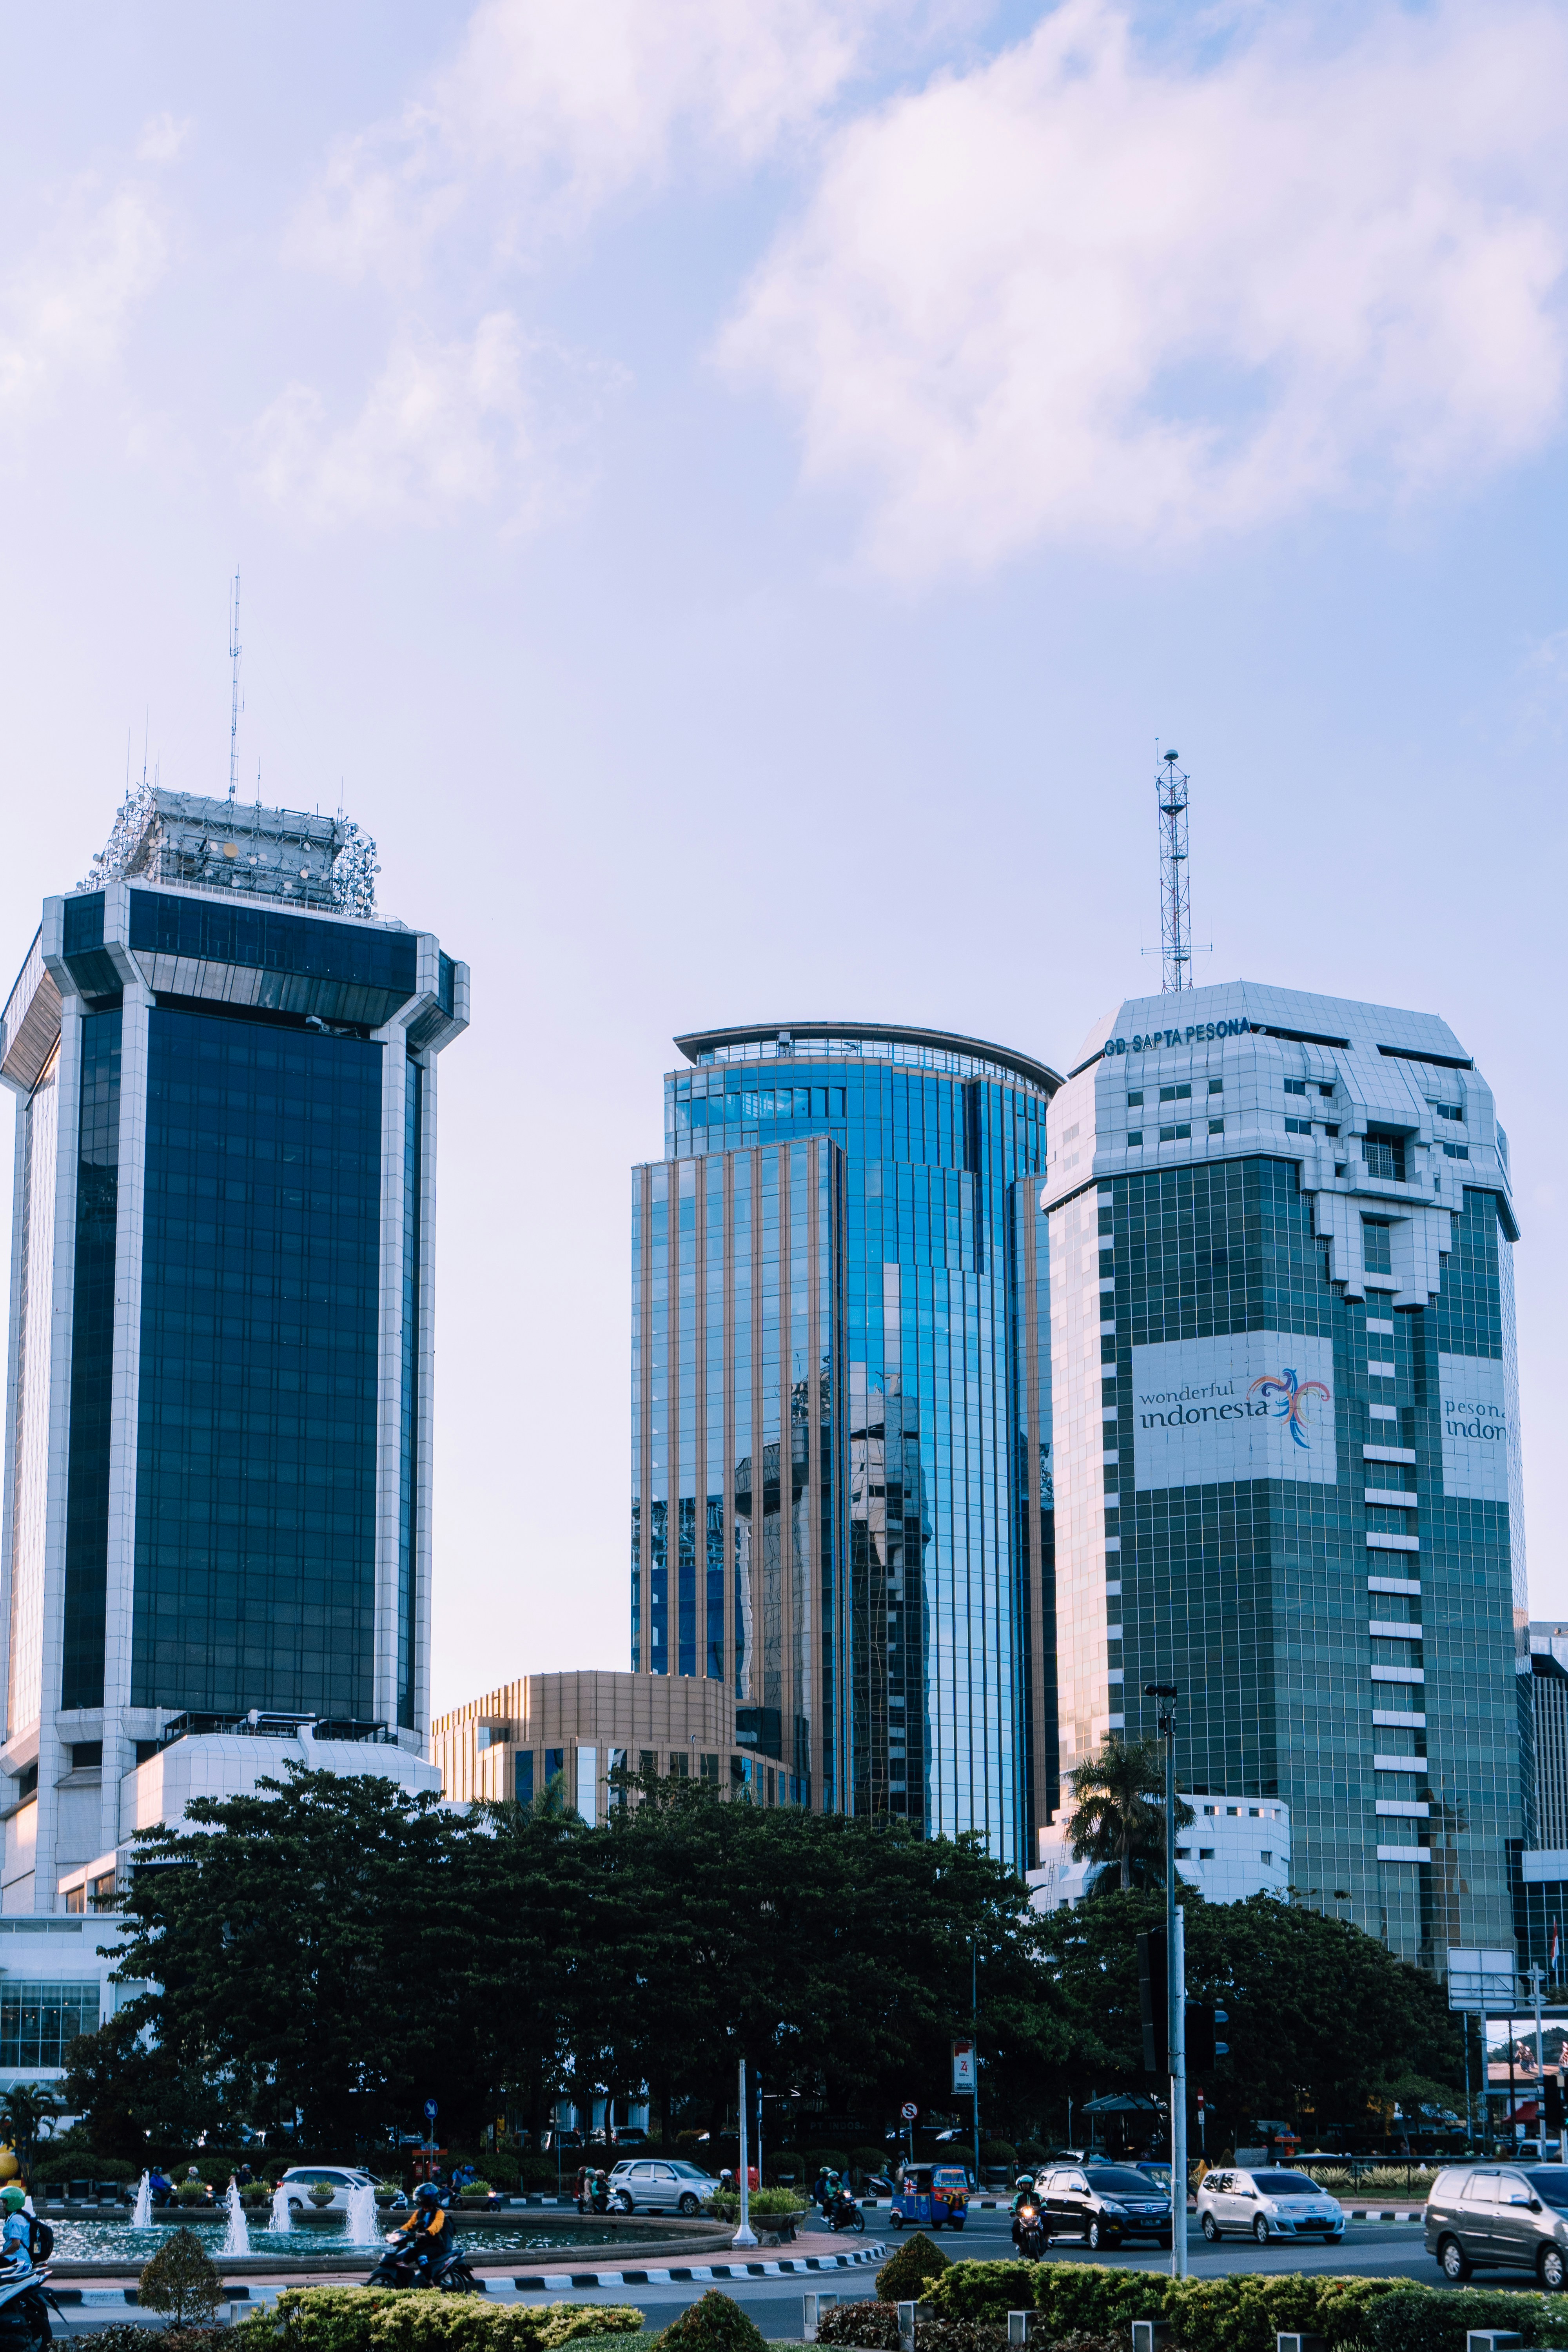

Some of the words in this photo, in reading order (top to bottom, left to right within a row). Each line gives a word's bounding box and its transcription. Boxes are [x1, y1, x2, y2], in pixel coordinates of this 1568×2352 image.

[1104, 1039, 1129, 1057] GD.
[1133, 1029, 1182, 1052] SAPTA
[1186, 1017, 1250, 1043] PESONA
[1139, 1381, 1235, 1405] wonderful
[1140, 1401, 1270, 1429] indonesia
[810, 2121, 823, 2130] PT
